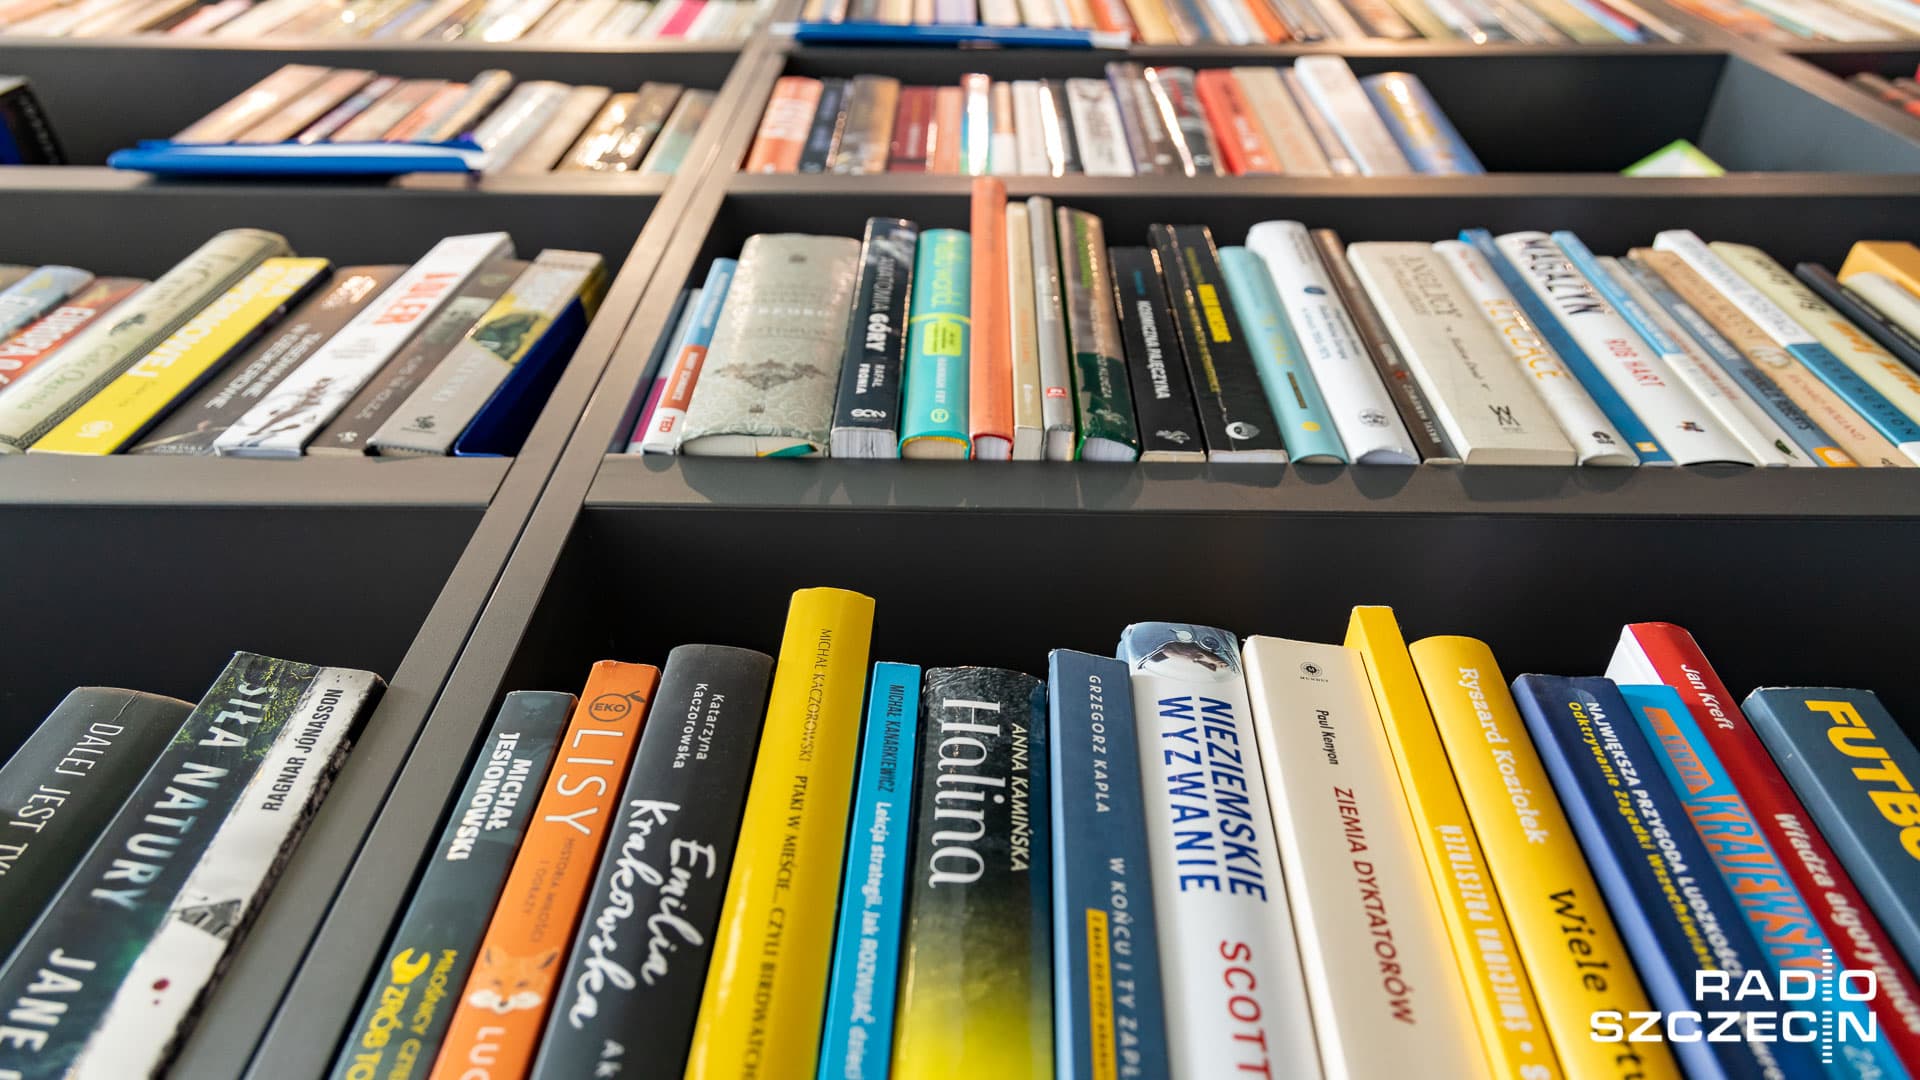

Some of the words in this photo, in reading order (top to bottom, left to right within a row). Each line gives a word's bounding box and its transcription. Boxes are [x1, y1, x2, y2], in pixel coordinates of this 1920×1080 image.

[865, 313, 892, 352] GÓRY
[1627, 356, 1666, 388] HART
[815, 628, 832, 669] MICHAŁ
[198, 681, 272, 749] SIŁA
[594, 702, 626, 713] EKO
[673, 682, 708, 769] Kaczorowska
[696, 693, 725, 761] Katarzyna
[798, 672, 825, 762] KACZOROWSKI
[886, 684, 905, 717] MICHAŁ
[1088, 674, 1107, 755] GRZEGORZ
[1315, 709, 1334, 732] Paul
[56, 722, 124, 777] DALEJ
[262, 755, 307, 812] RAGNAR
[304, 687, 345, 757] JÓNASSON
[544, 728, 624, 836] LISY
[877, 720, 902, 793] KANARKIEWICZ
[1011, 722, 1028, 772] ANNA
[1321, 729, 1340, 765] Kenyon
[1681, 663, 1706, 690] Jan
[1698, 692, 1735, 730] Kreft
[1774, 813, 1836, 888] Władza
[9, 784, 71, 833] JEST
[446, 732, 520, 861] JESIONOWSKI
[485, 758, 532, 831] MICHAŁ
[786, 816, 802, 832] W
[790, 775, 808, 811] PTAKI
[869, 801, 892, 842] Lekcja
[928, 697, 1006, 889] Halina
[1010, 776, 1034, 872] KAMIŃSKA
[1157, 695, 1221, 893] WYZWANIE
[1199, 695, 1268, 903] NIEZIEMSKIE
[1333, 786, 1368, 854] ZIEMIA
[1586, 701, 1641, 787] NAJWIĘKSZA
[1631, 788, 1688, 875] PRZYGODA
[92, 761, 230, 910] NATURY
[1109, 857, 1125, 876] W
[1457, 666, 1510, 745] Ryszard
[1491, 747, 1550, 845] Koziołek
[1549, 888, 1610, 994] Wiele
[1434, 824, 1494, 922] PRZESTRZEŃ
[569, 799, 681, 1029] Krakowska
[641, 838, 717, 987] Emilia
[764, 907, 785, 956] CZYLI
[1111, 881, 1134, 955] KOŃCU
[1352, 860, 1417, 1026] DYKTATORÓW
[0, 948, 97, 1053] JANE
[361, 984, 410, 1049] ZRÓB
[1116, 979, 1136, 1009] TY
[1219, 939, 1274, 1080] SCOTT
